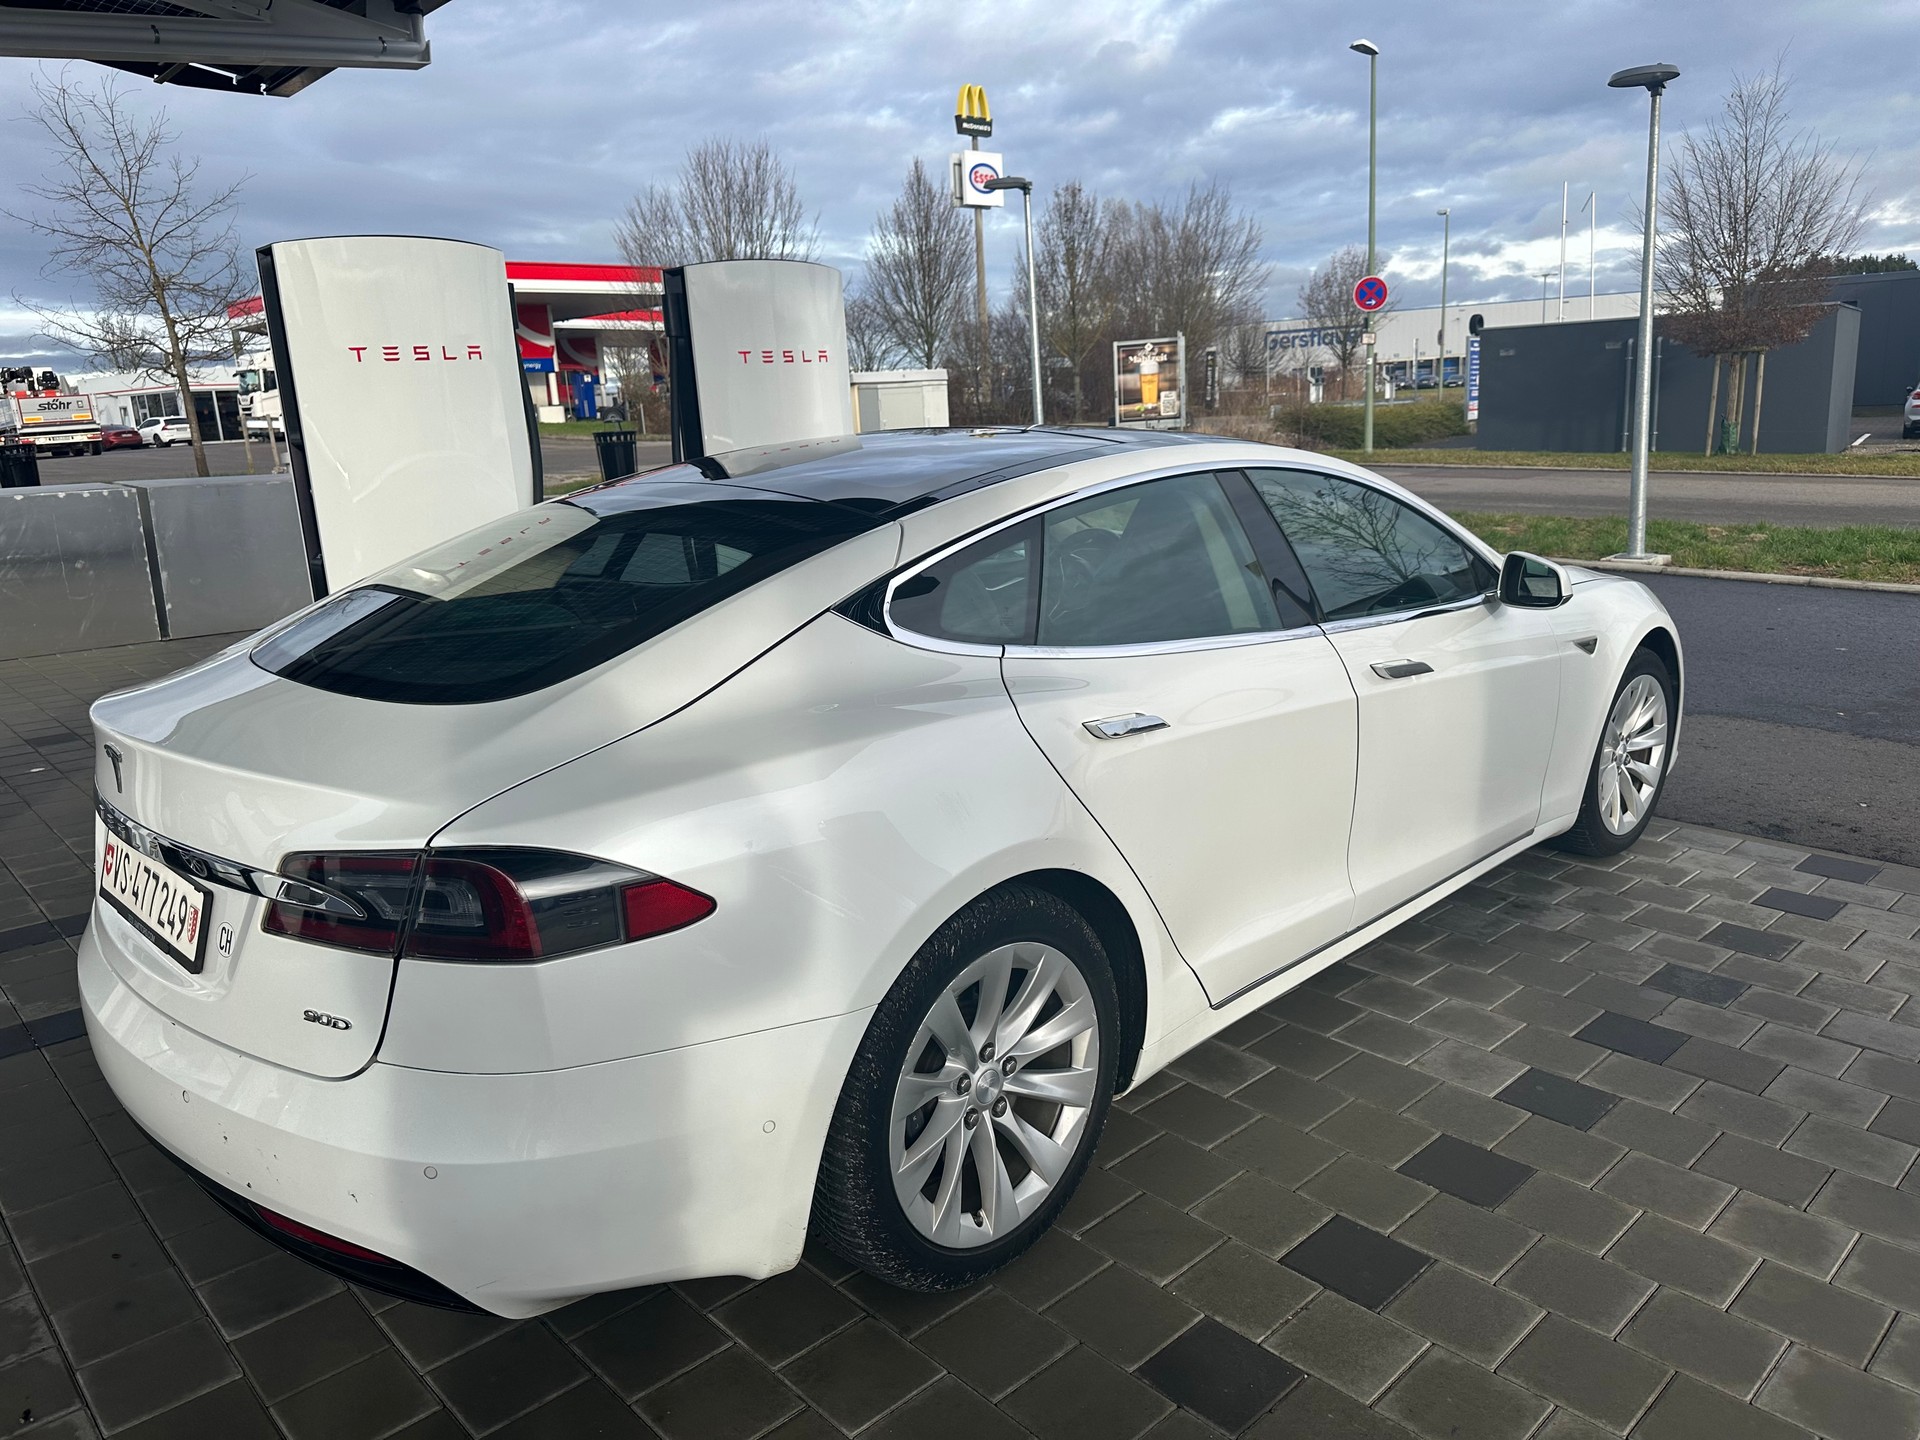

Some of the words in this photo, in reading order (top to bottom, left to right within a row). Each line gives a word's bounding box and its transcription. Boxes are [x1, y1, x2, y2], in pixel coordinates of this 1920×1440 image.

[348, 346, 482, 362] TESLA
[738, 350, 828, 364] TESLA
[37, 398, 72, 411] stöhr
[219, 926, 233, 955] CH
[303, 1008, 352, 1031] 90D
